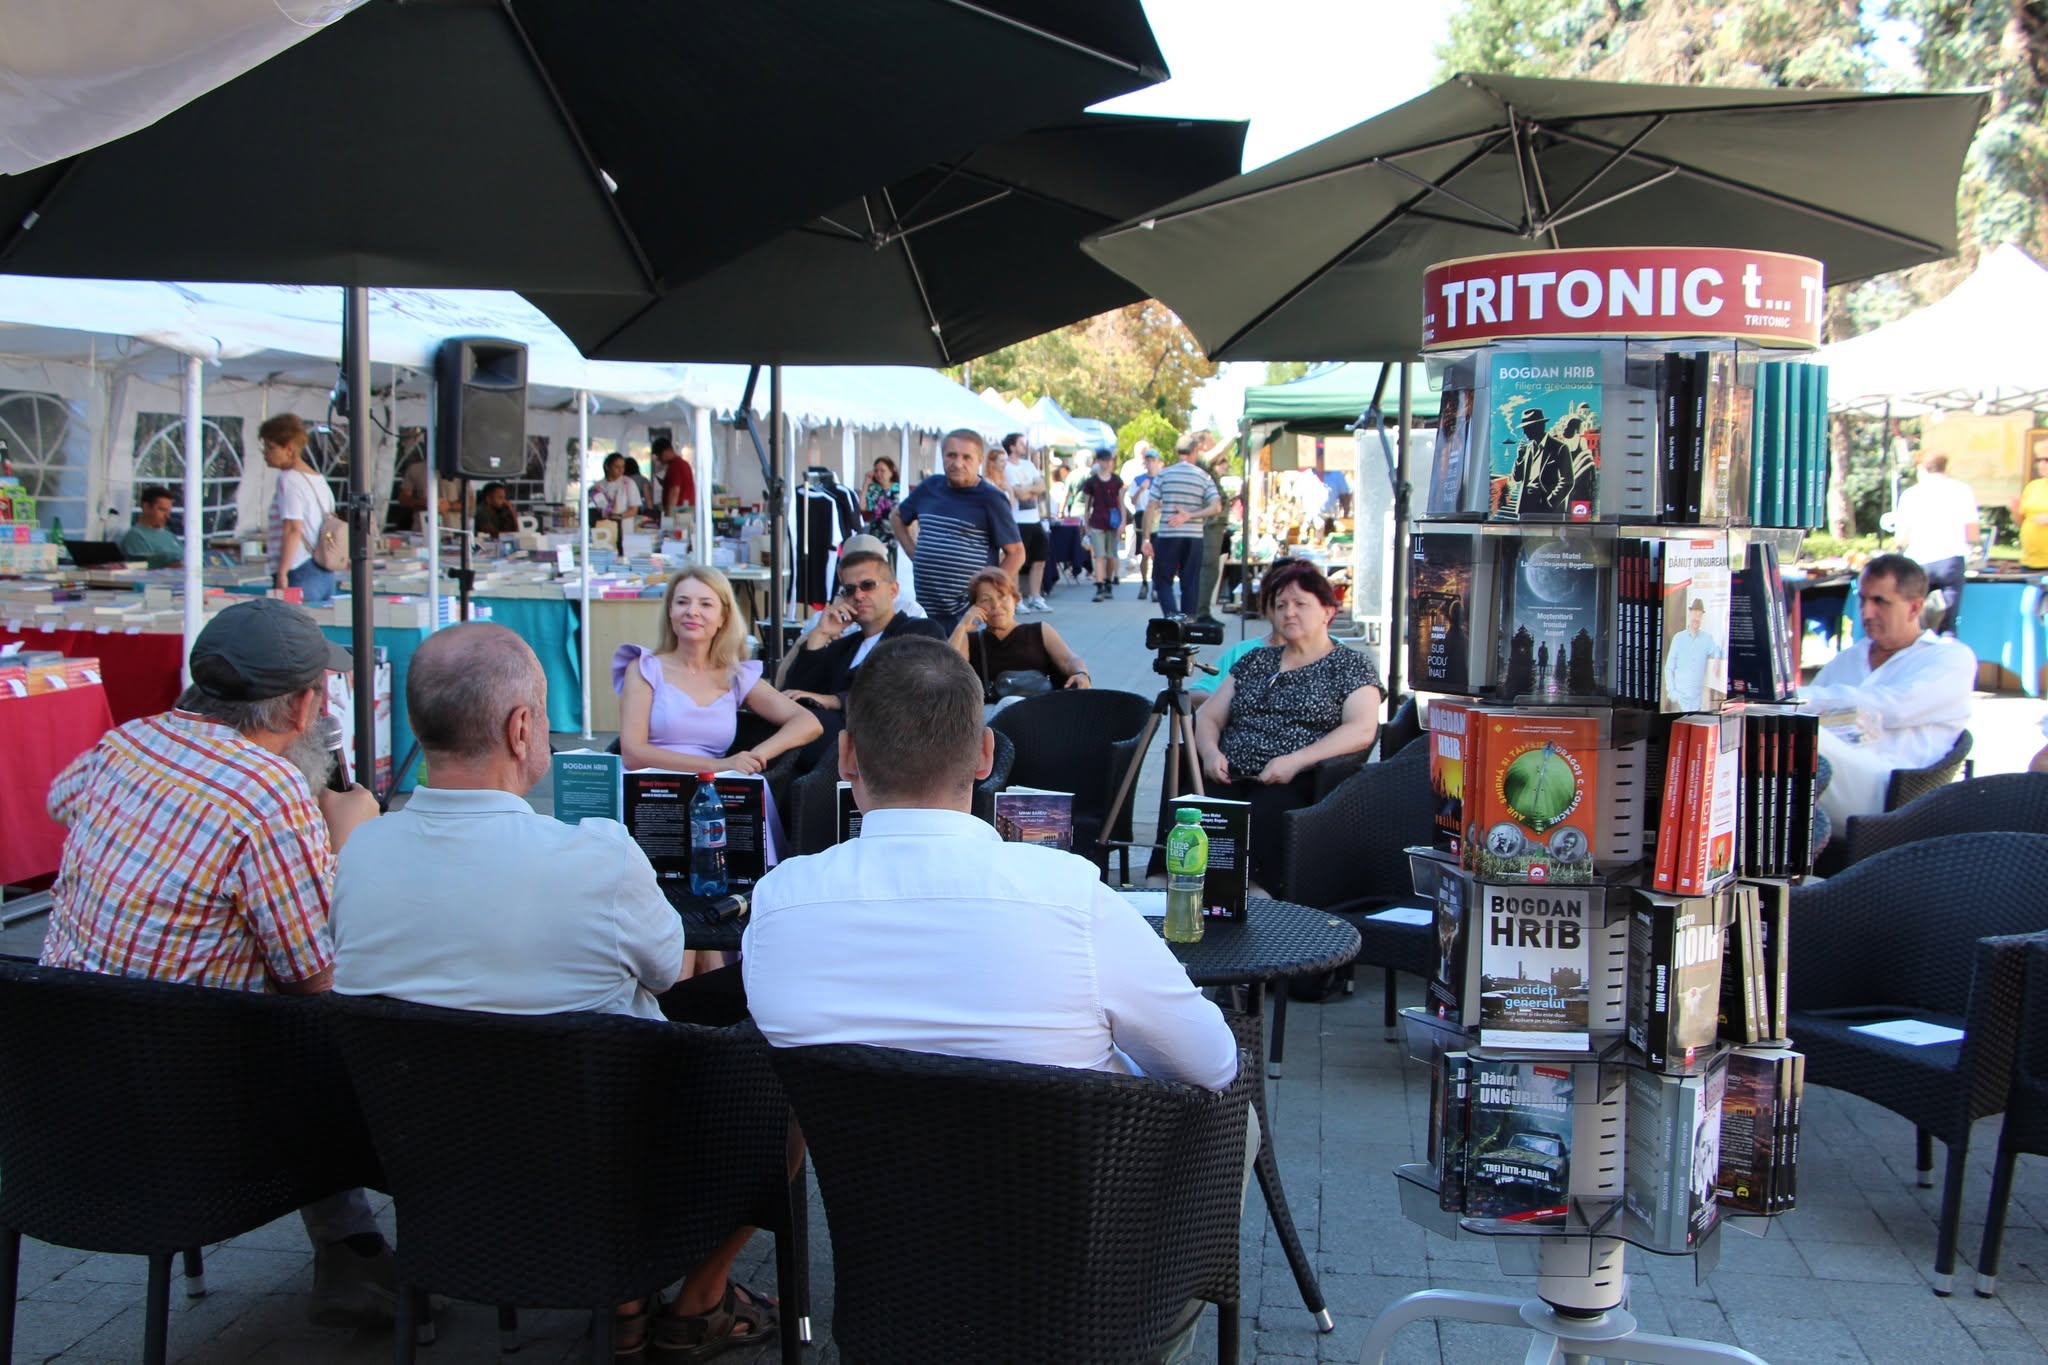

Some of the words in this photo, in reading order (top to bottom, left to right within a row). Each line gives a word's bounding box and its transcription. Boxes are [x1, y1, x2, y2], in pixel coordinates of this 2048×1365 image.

[1442, 267, 1724, 328] TRITONIC
[1744, 314, 1791, 329] TRITONIC
[1500, 366, 1559, 379] BOGDAN
[1564, 366, 1595, 378] HRIB
[1431, 644, 1444, 654] SUB
[1428, 668, 1446, 678] ÎNALT
[1438, 734, 1460, 760] HRIB
[1555, 746, 1583, 776] DRAGOȘ
[1550, 790, 1583, 825] COSTACHE
[1170, 838, 1189, 850] fuze
[1170, 848, 1184, 857] tea
[1492, 896, 1581, 918] BOGDAN
[1490, 916, 1581, 950] HRIB
[1674, 924, 1718, 970] NOIR
[1656, 964, 1666, 992] gastro
[1512, 984, 1558, 996] ucideți
[1504, 996, 1566, 1010] generalul
[1656, 992, 1666, 1012] NOIR
[1480, 1088, 1568, 1112] UNGUREANU
[1502, 1164, 1526, 1176] ÎNTR-O
[1528, 1169, 1549, 1181] RABLĂ
